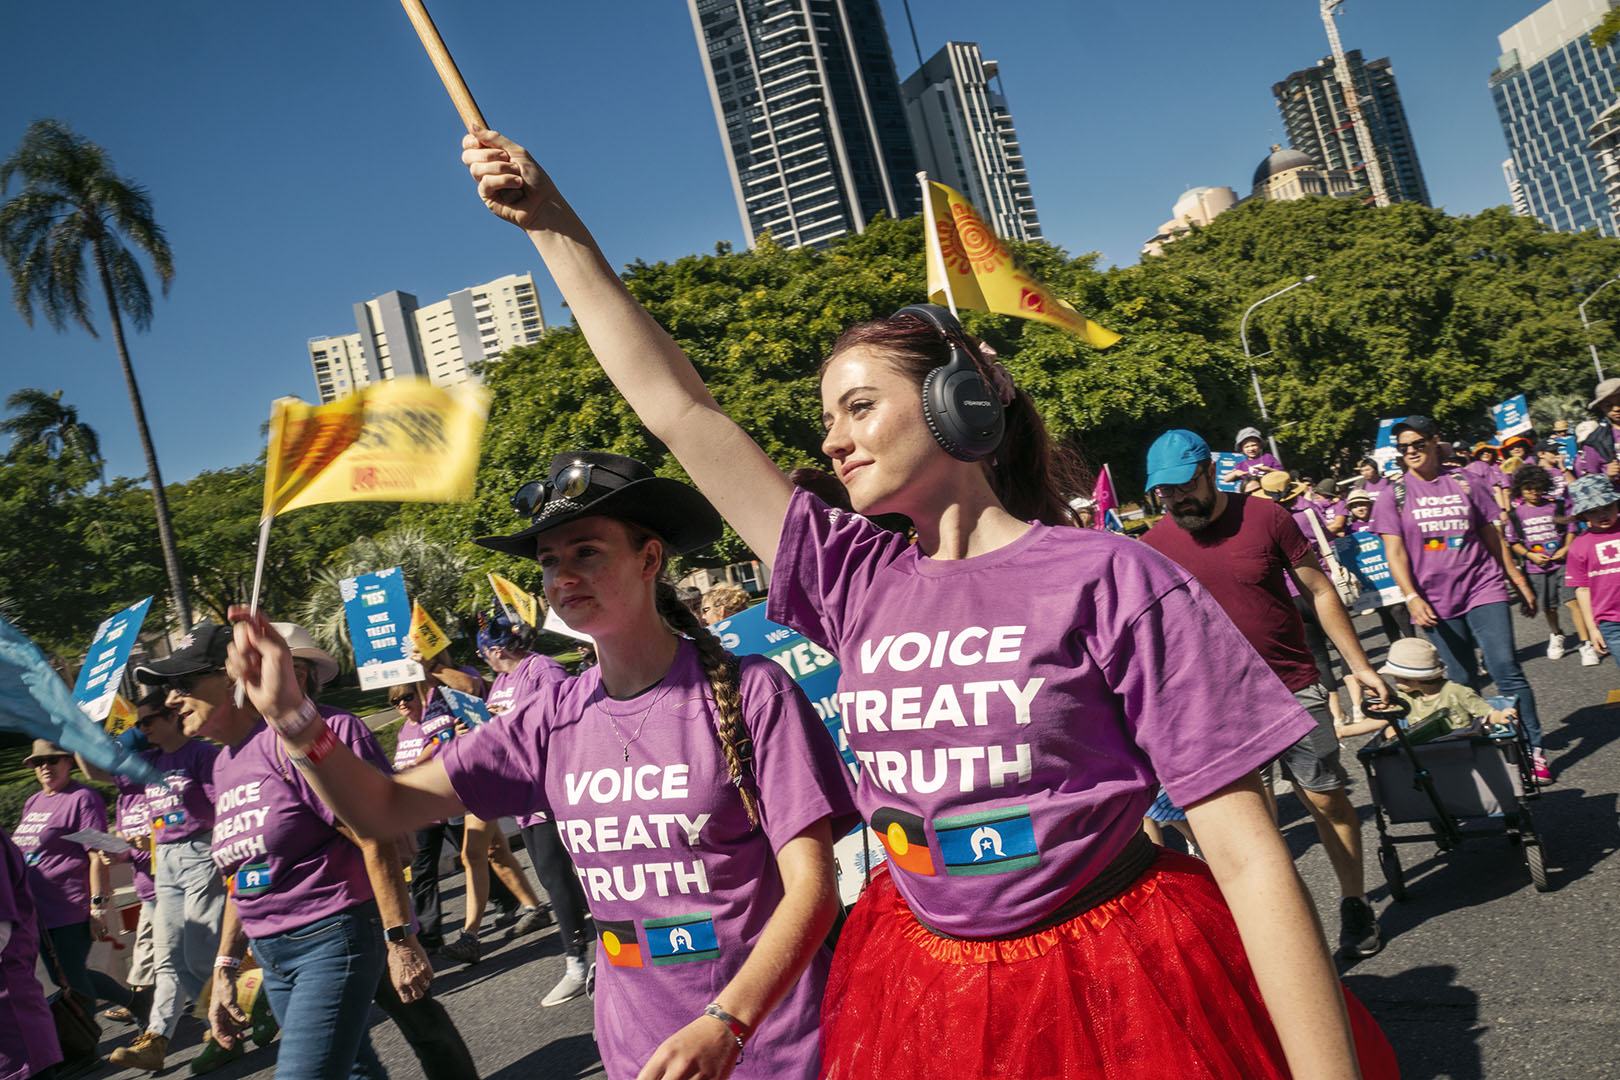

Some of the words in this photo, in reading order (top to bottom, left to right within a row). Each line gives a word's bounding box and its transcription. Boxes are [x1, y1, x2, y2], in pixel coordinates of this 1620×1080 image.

[1411, 505, 1469, 519] TREATY
[1416, 494, 1463, 506] VOICE
[1417, 519, 1470, 533] TRUTH
[861, 625, 1027, 675] VOICE
[839, 677, 1046, 734] TREATY
[565, 764, 689, 805] VOICE
[855, 743, 1033, 794] TRUTH
[213, 806, 270, 843] REATY
[556, 813, 711, 854] TREATY
[577, 859, 710, 901] TRUTH
